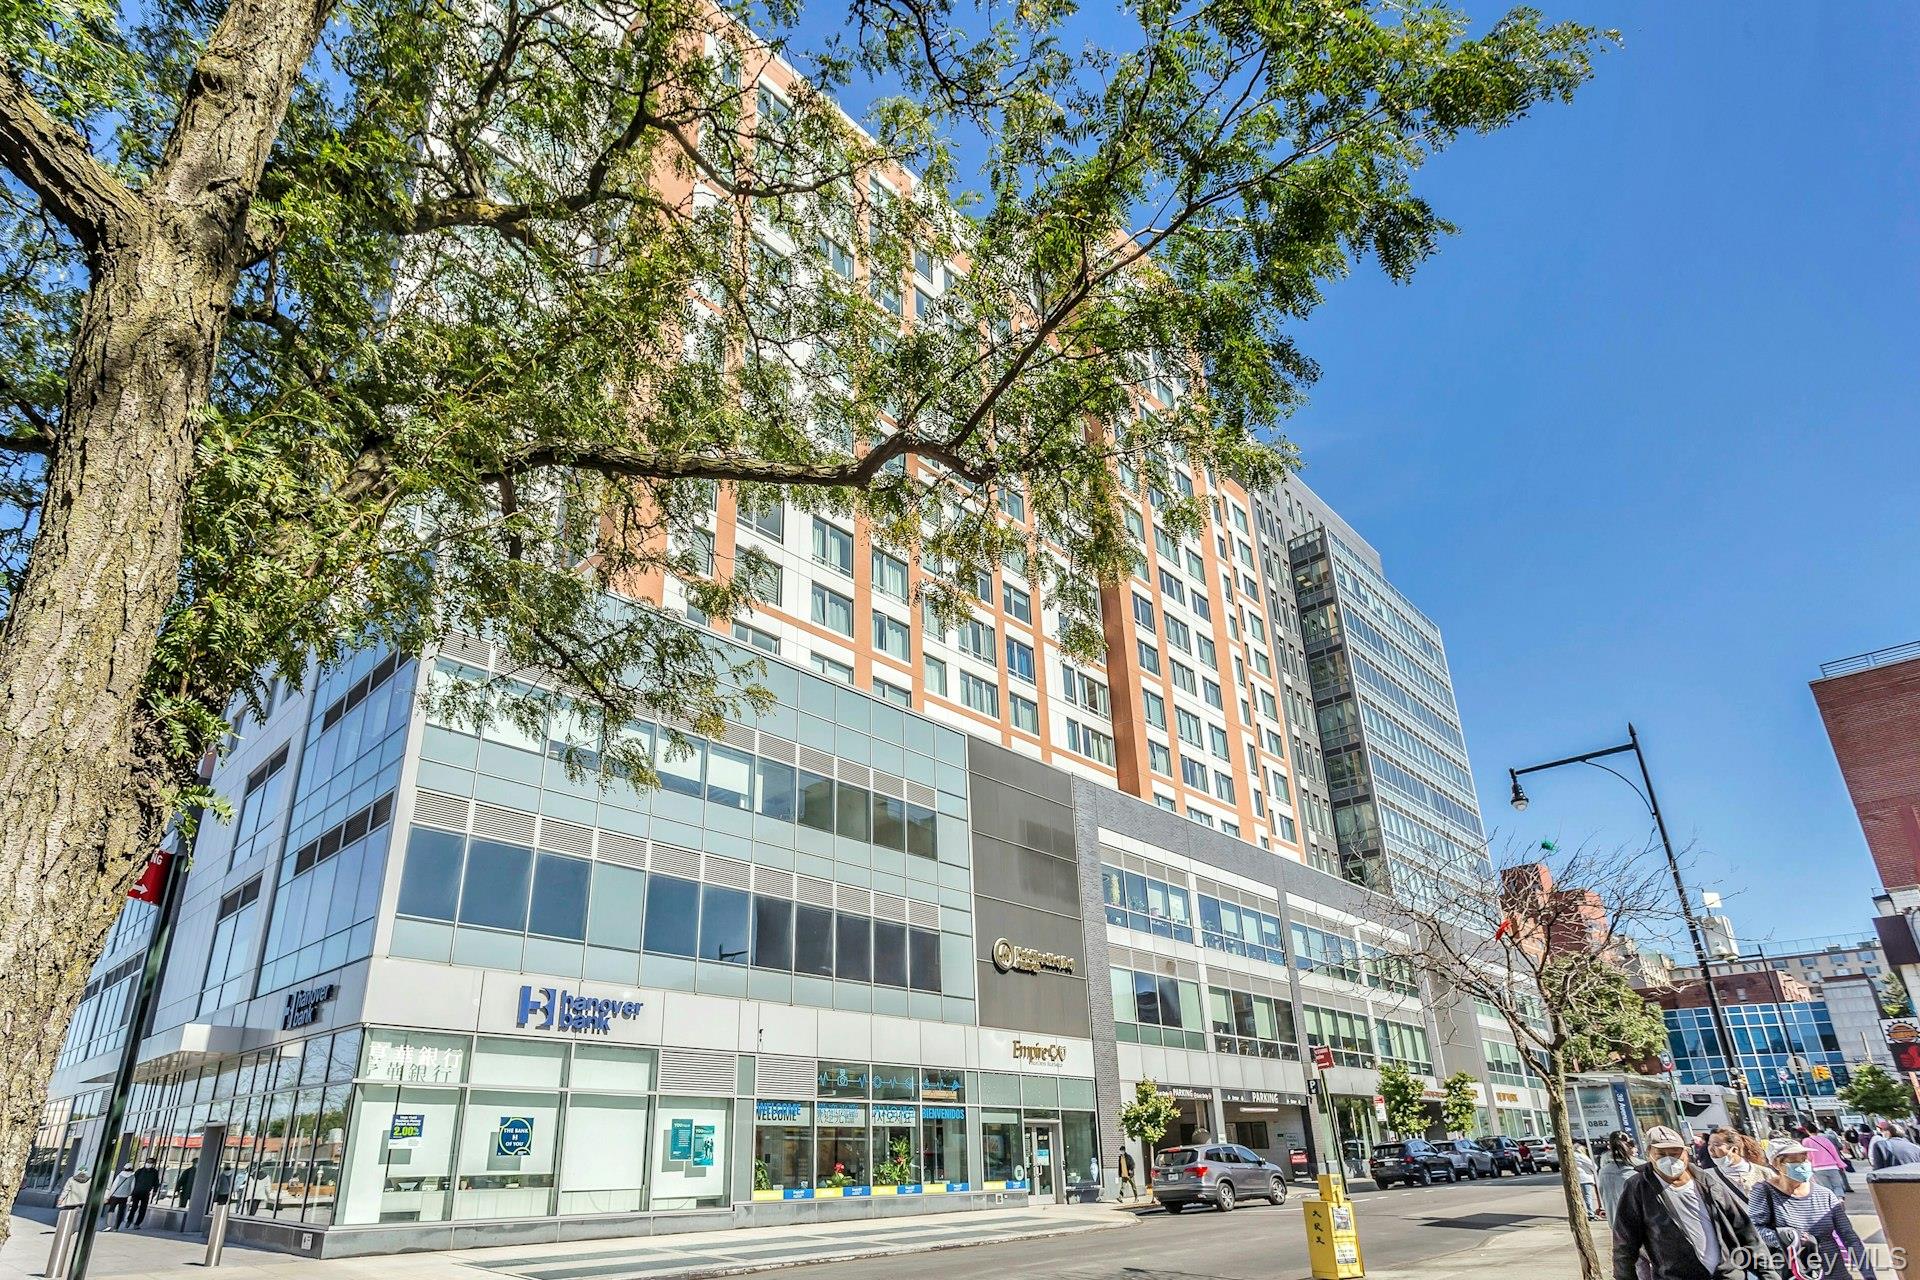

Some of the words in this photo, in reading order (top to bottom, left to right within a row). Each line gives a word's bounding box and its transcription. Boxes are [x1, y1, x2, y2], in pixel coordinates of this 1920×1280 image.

[560, 990, 643, 1018] hanover
[559, 1008, 611, 1031] bank
[1251, 1091, 1279, 1104] PARKING
[921, 1107, 965, 1119] BIENVENIDOS
[1587, 1119, 1609, 1128] 0882
